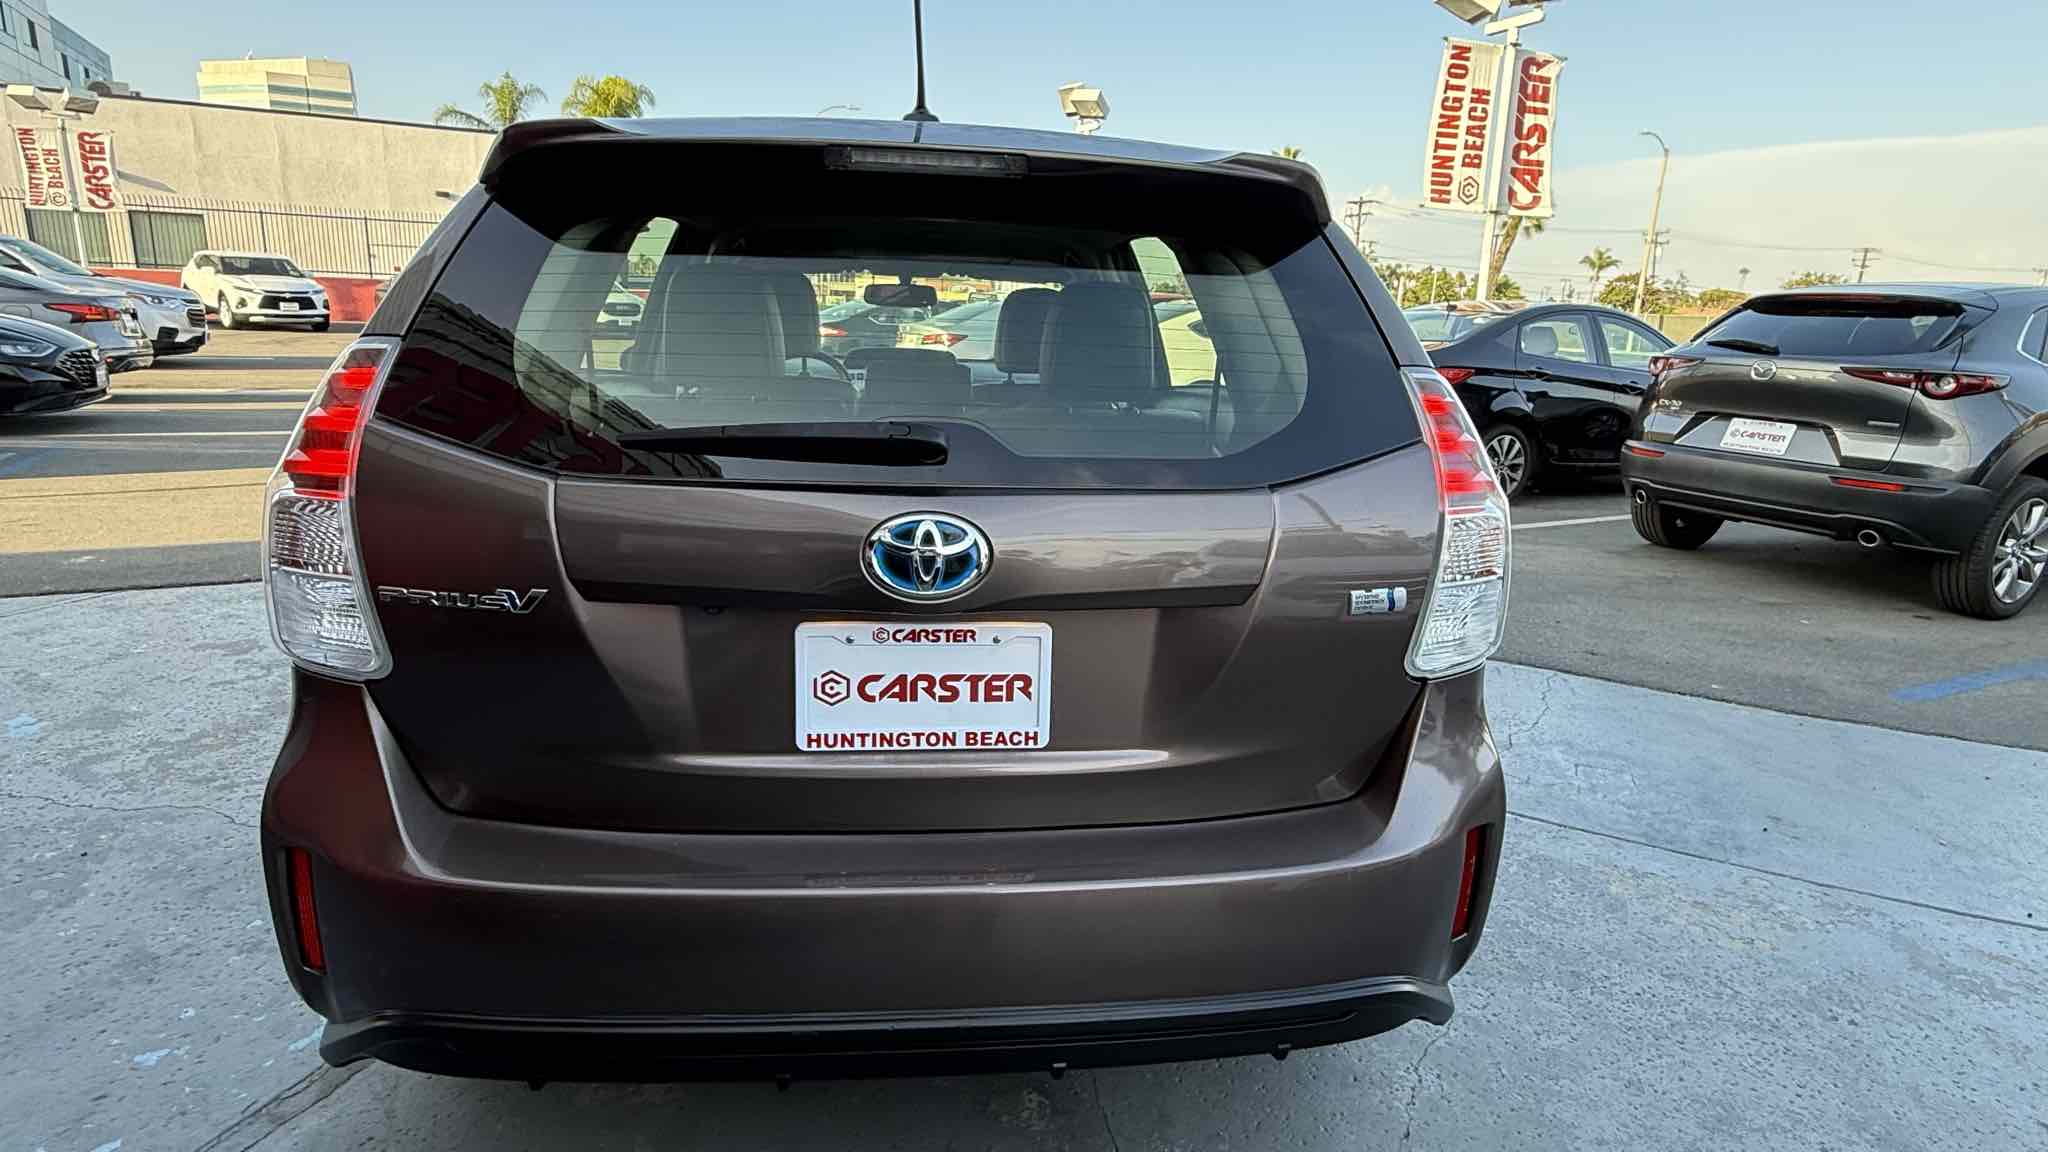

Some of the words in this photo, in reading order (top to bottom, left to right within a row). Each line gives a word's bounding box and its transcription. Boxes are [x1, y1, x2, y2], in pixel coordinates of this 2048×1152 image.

[1430, 44, 1473, 205] HUNTINGTON
[1461, 87, 1491, 169] BEACH
[1508, 56, 1554, 211] CARSTER
[16, 128, 47, 206] HUNTINGTON
[41, 148, 64, 188] BEACH
[78, 131, 115, 209] CARSTER
[892, 629, 976, 643] CARSTER
[857, 673, 1032, 702] CARSTER
[806, 732, 957, 748] HUNTINGTON
[965, 731, 1039, 746] BEACH
